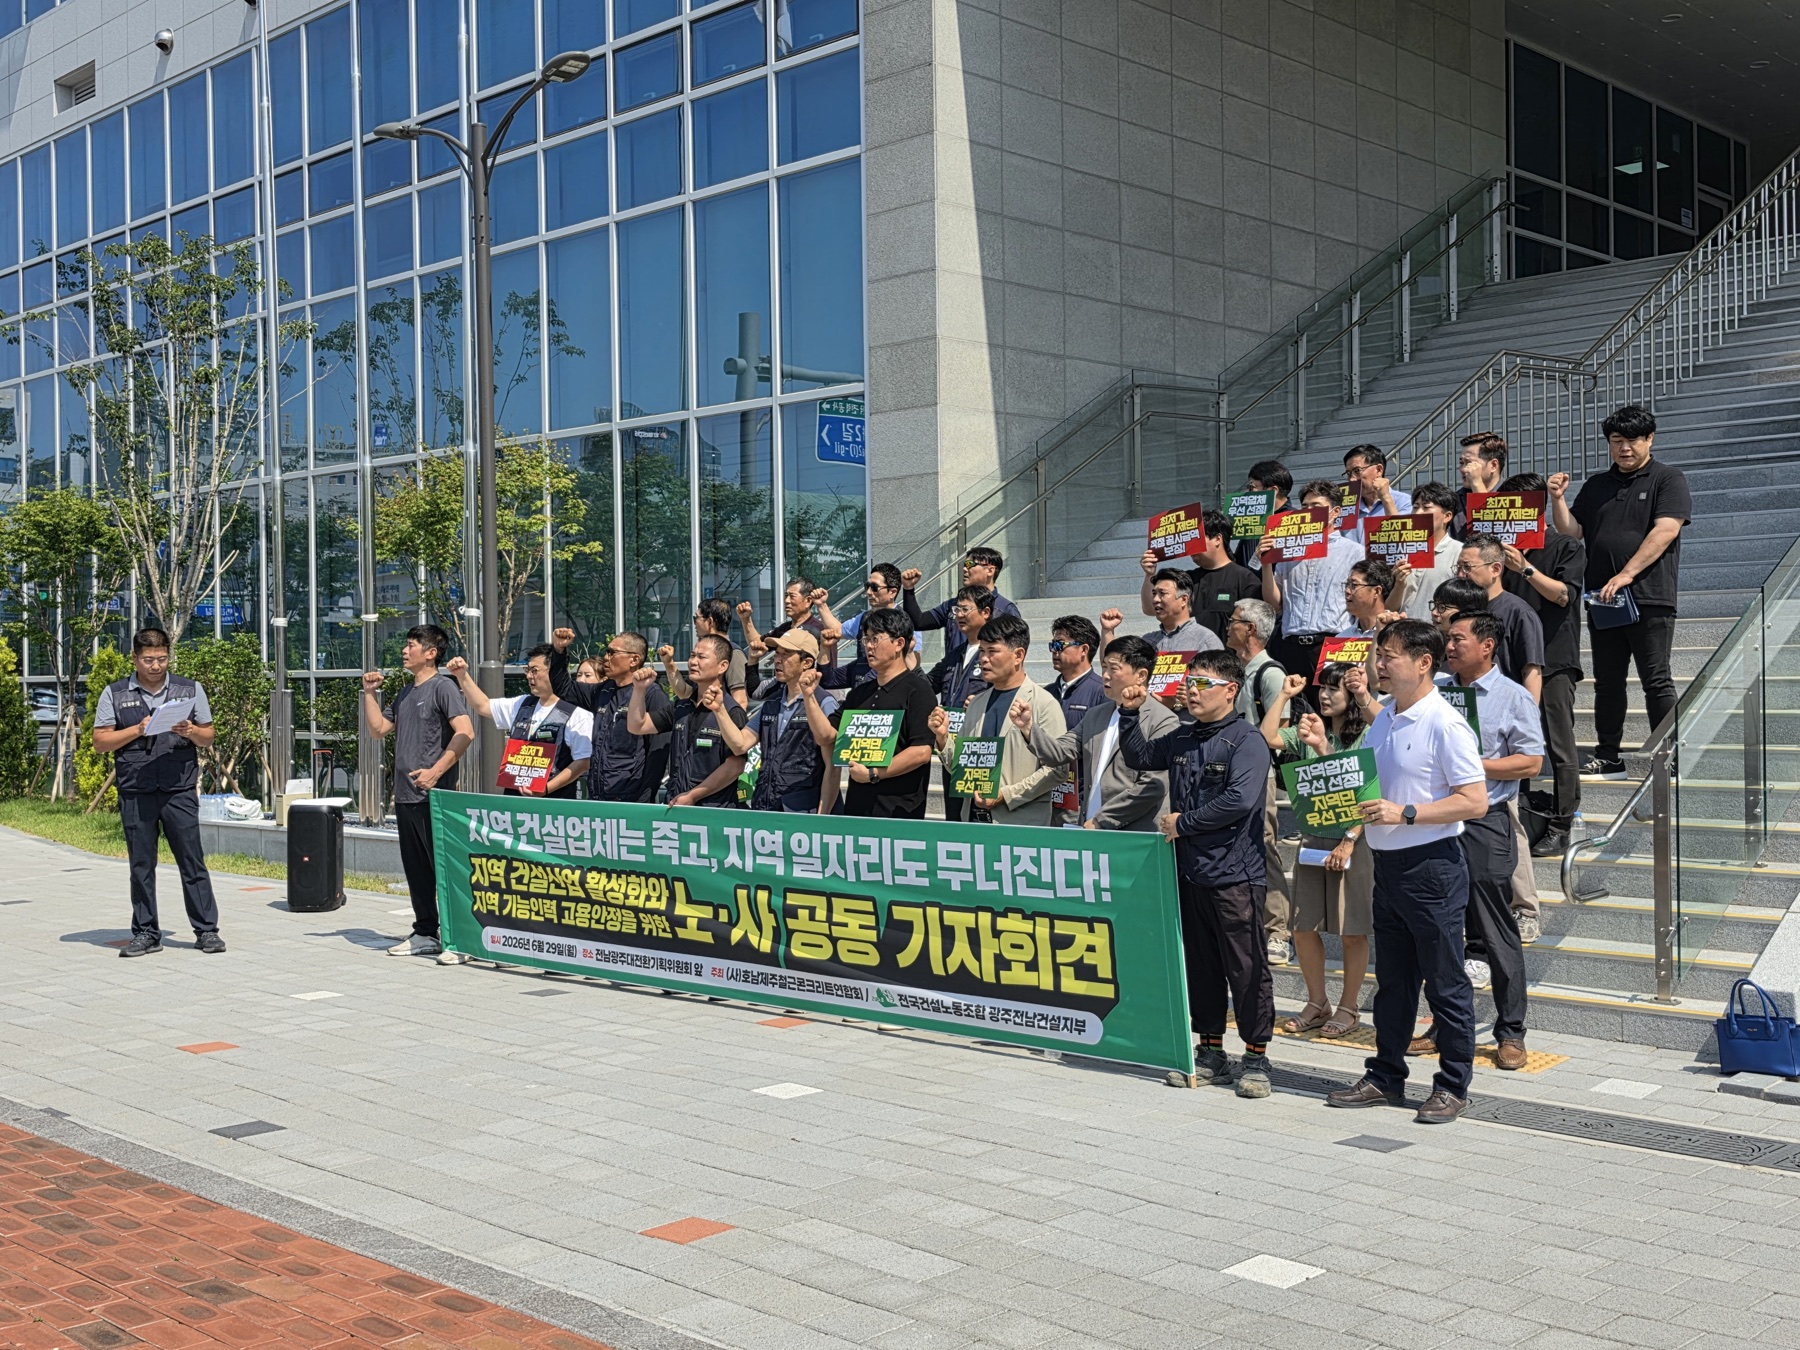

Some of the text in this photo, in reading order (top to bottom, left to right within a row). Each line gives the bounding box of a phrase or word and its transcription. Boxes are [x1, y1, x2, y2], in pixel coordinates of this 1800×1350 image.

[1231, 494, 1267, 507] 지역업체
[1486, 495, 1522, 509] 최저가
[1228, 504, 1268, 516] 우선 선정!
[1472, 507, 1539, 520] 낙찰제 제한!
[1160, 510, 1186, 527] 최저가
[1233, 515, 1261, 527] 지역민
[1280, 512, 1312, 526] 최저가
[1381, 518, 1413, 531] 최저가
[1150, 518, 1198, 538] 낙찰제 제한!
[1268, 521, 1324, 538] 낙찰제 제한!
[1472, 520, 1538, 533] 적정 공사금액
[1150, 528, 1200, 549] 적정 공사금액
[1286, 532, 1323, 547] 공사금액
[1369, 529, 1428, 543] 낙찰제 제한!
[1164, 542, 1186, 557] 보장!
[1282, 546, 1306, 558] 보장!
[1370, 541, 1428, 555] 적정 공사금액
[1325, 651, 1362, 662] 낙찰제
[849, 714, 894, 726] 지역업체
[844, 725, 893, 737] 우선 선정!
[519, 744, 544, 757] 최저가
[849, 737, 882, 750] 지역민
[962, 741, 998, 754] 지역업체
[839, 749, 887, 762] 우선 고용!
[958, 754, 998, 767] 우선 선정!
[963, 768, 990, 780] 지역민
[1294, 755, 1360, 782] 지역업체
[955, 780, 994, 794] 우선 고용!
[1296, 770, 1364, 797] 우선 선정!
[1310, 789, 1357, 812] 지역민
[1305, 809, 1337, 828] 우선
[465, 807, 1112, 903] 지역 건설업체는 죽고, 지역 일자리도 무너진다!
[470, 856, 670, 911] 지역 건설산업 활성화와
[473, 890, 673, 939] 지역 기능인력 고용안정을 위한
[785, 891, 881, 967] 공동
[891, 905, 1116, 999] 기자회견
[490, 934, 501, 945] 일시
[501, 935, 531, 952] 2026년
[531, 940, 545, 954] 6월
[545, 941, 578, 958] 29일(월)
[582, 948, 594, 959] 장소
[595, 948, 693, 976] 전남광주대전환기획위원회
[694, 962, 704, 977] 앞
[710, 967, 725, 979] 주최
[896, 993, 987, 1021] 전국건설노동조합
[988, 1005, 1087, 1036] 광주전남건설지부
